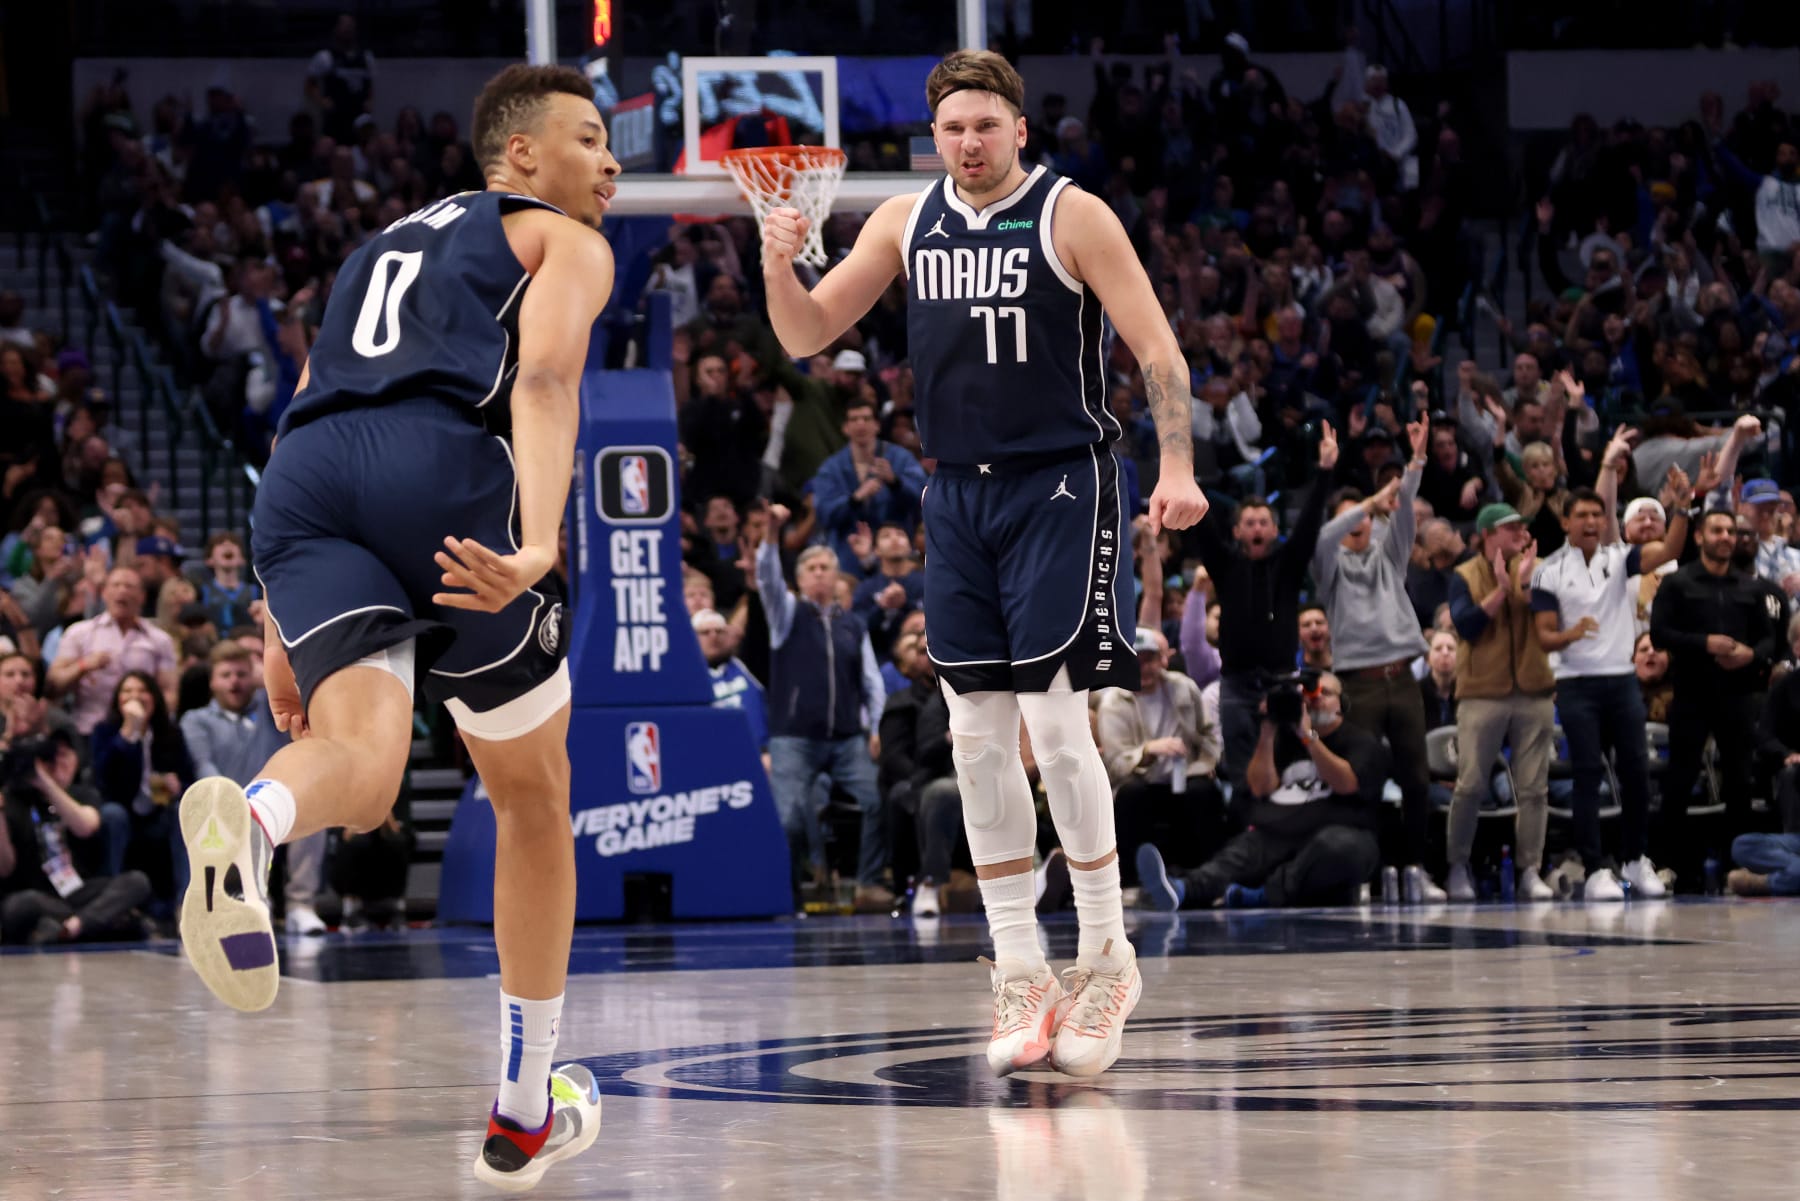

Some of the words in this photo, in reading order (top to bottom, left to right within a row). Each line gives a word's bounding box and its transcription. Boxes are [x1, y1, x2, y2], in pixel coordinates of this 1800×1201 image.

[998, 218, 1034, 231] chime
[915, 247, 1030, 300] MAVS
[352, 250, 423, 358] 0
[970, 306, 1028, 364] 77
[610, 529, 663, 575] GET
[611, 578, 667, 624] THE
[613, 625, 669, 673] APP
[571, 780, 753, 838] VERYONE'S
[595, 815, 696, 857] GAME
